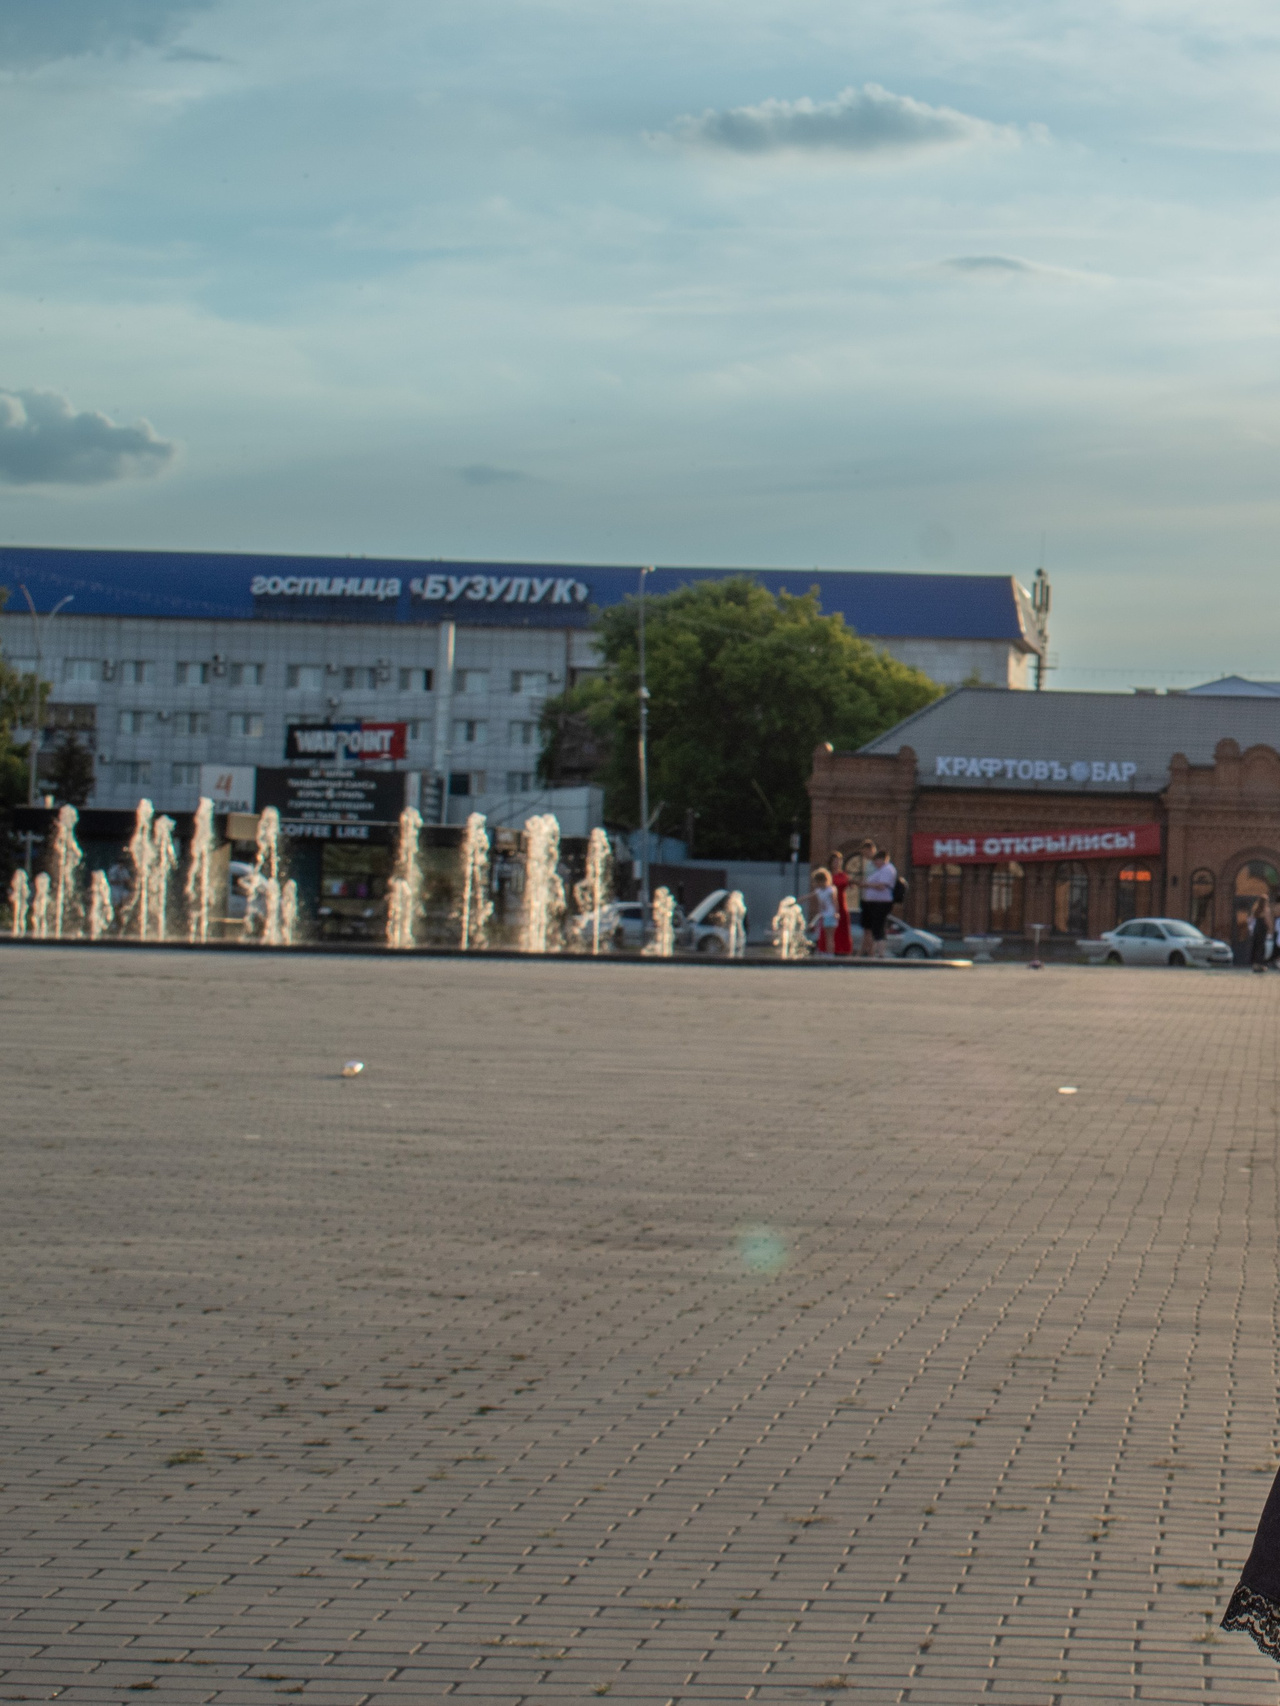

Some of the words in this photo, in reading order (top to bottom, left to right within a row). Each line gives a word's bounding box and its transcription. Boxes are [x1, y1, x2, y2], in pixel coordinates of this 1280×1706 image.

[410, 574, 589, 603] «БУЗУЛУК»
[935, 756, 1068, 780] КРАФТОВЪ
[1090, 761, 1137, 782] БАР
[336, 825, 369, 839] LIKE
[933, 839, 976, 857] МЫ
[983, 832, 1136, 855] ОТКРЫЛИСЬ!
